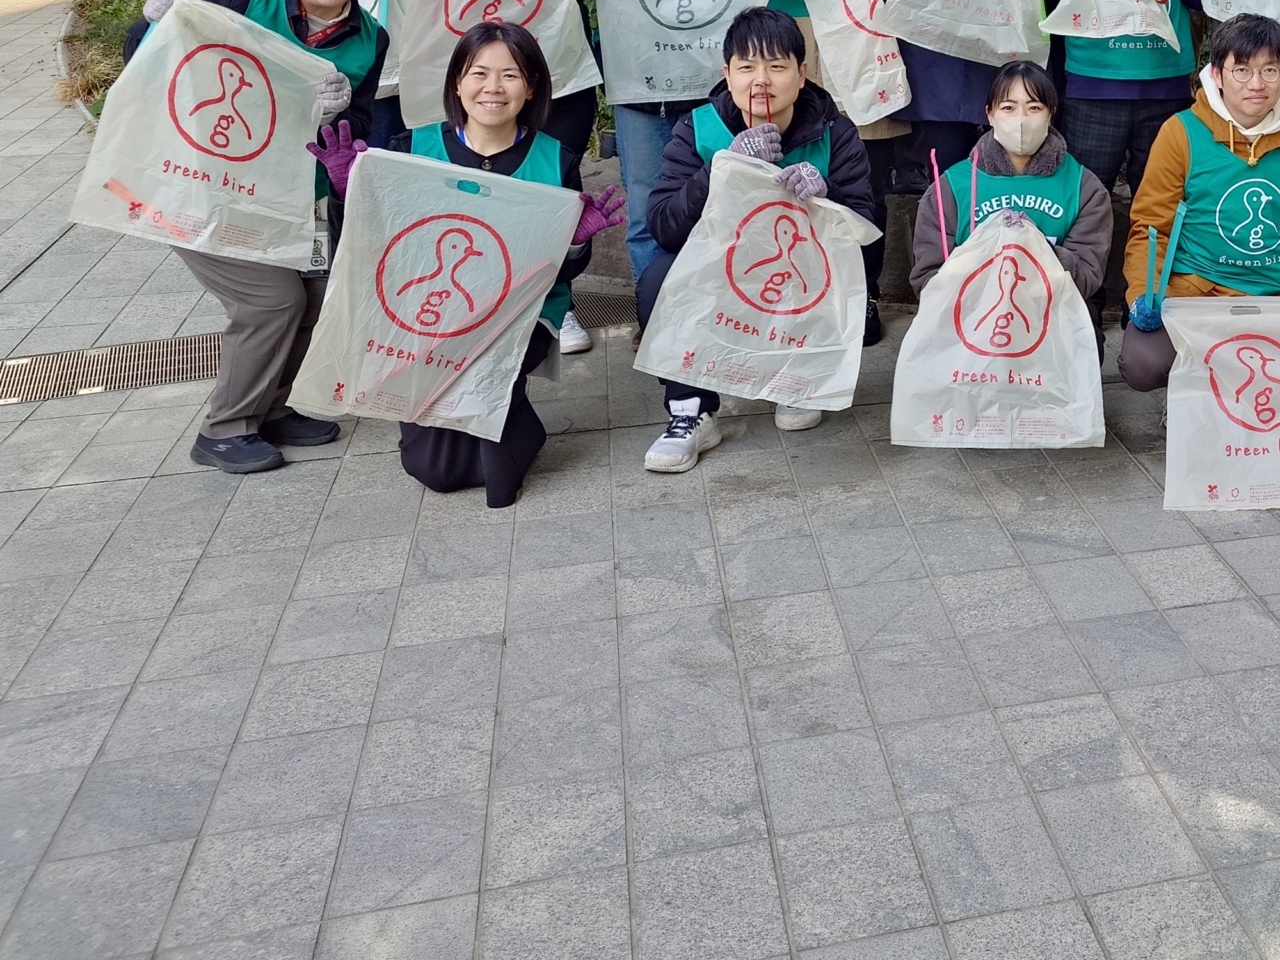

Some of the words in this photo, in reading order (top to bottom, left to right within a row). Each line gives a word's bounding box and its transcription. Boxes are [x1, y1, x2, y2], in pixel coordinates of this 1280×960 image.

[654, 40, 693, 52] green
[700, 37, 721, 50] bir
[1108, 38, 1144, 49] green
[1147, 39, 1168, 48] bird
[877, 52, 898, 66] gre
[162, 159, 212, 183] green
[222, 172, 256, 197] bird
[973, 194, 1065, 221] GREENBIRD
[1218, 255, 1262, 267] green
[715, 312, 760, 337] green
[768, 326, 808, 349] bird
[366, 339, 417, 362] green
[425, 350, 467, 373] bird
[952, 370, 998, 383] green
[1008, 369, 1042, 387] bird
[1225, 444, 1270, 458] green
